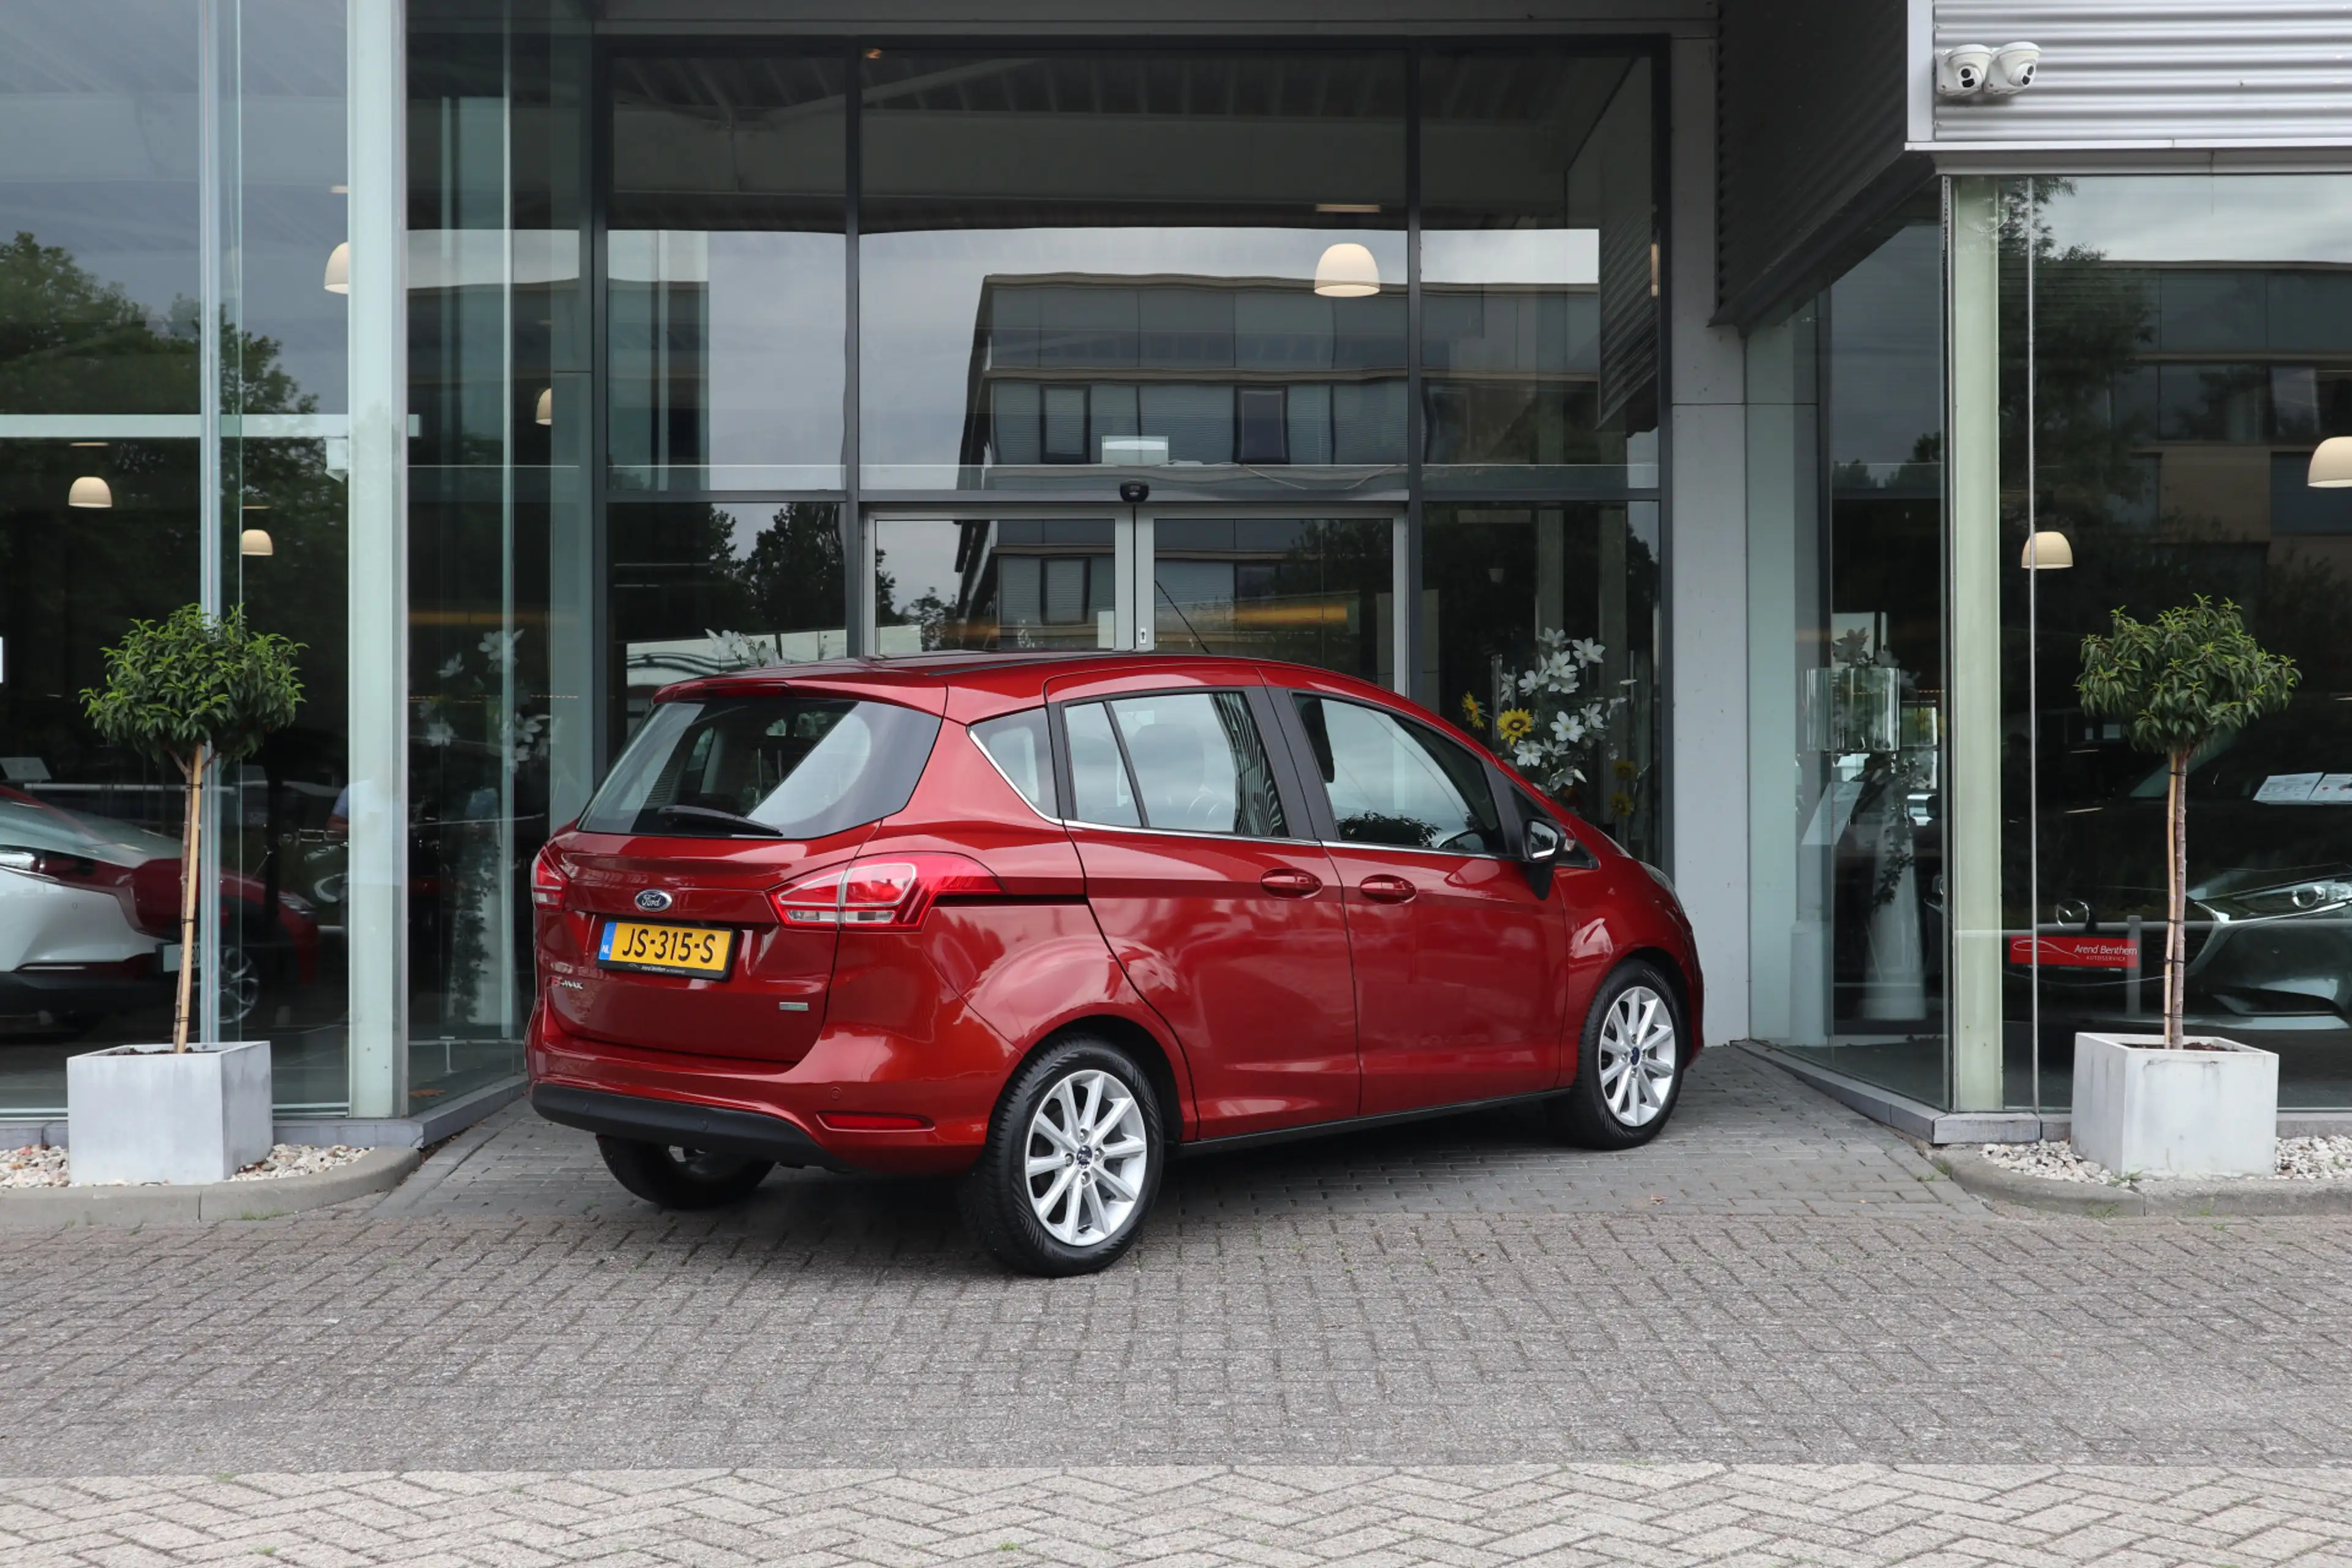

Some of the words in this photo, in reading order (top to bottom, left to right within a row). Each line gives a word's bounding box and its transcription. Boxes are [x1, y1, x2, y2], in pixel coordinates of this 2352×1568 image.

[641, 893, 662, 907] Ford
[601, 944, 610, 954] NL
[622, 928, 716, 963] JS-315-S
[2074, 944, 2100, 954] Arend
